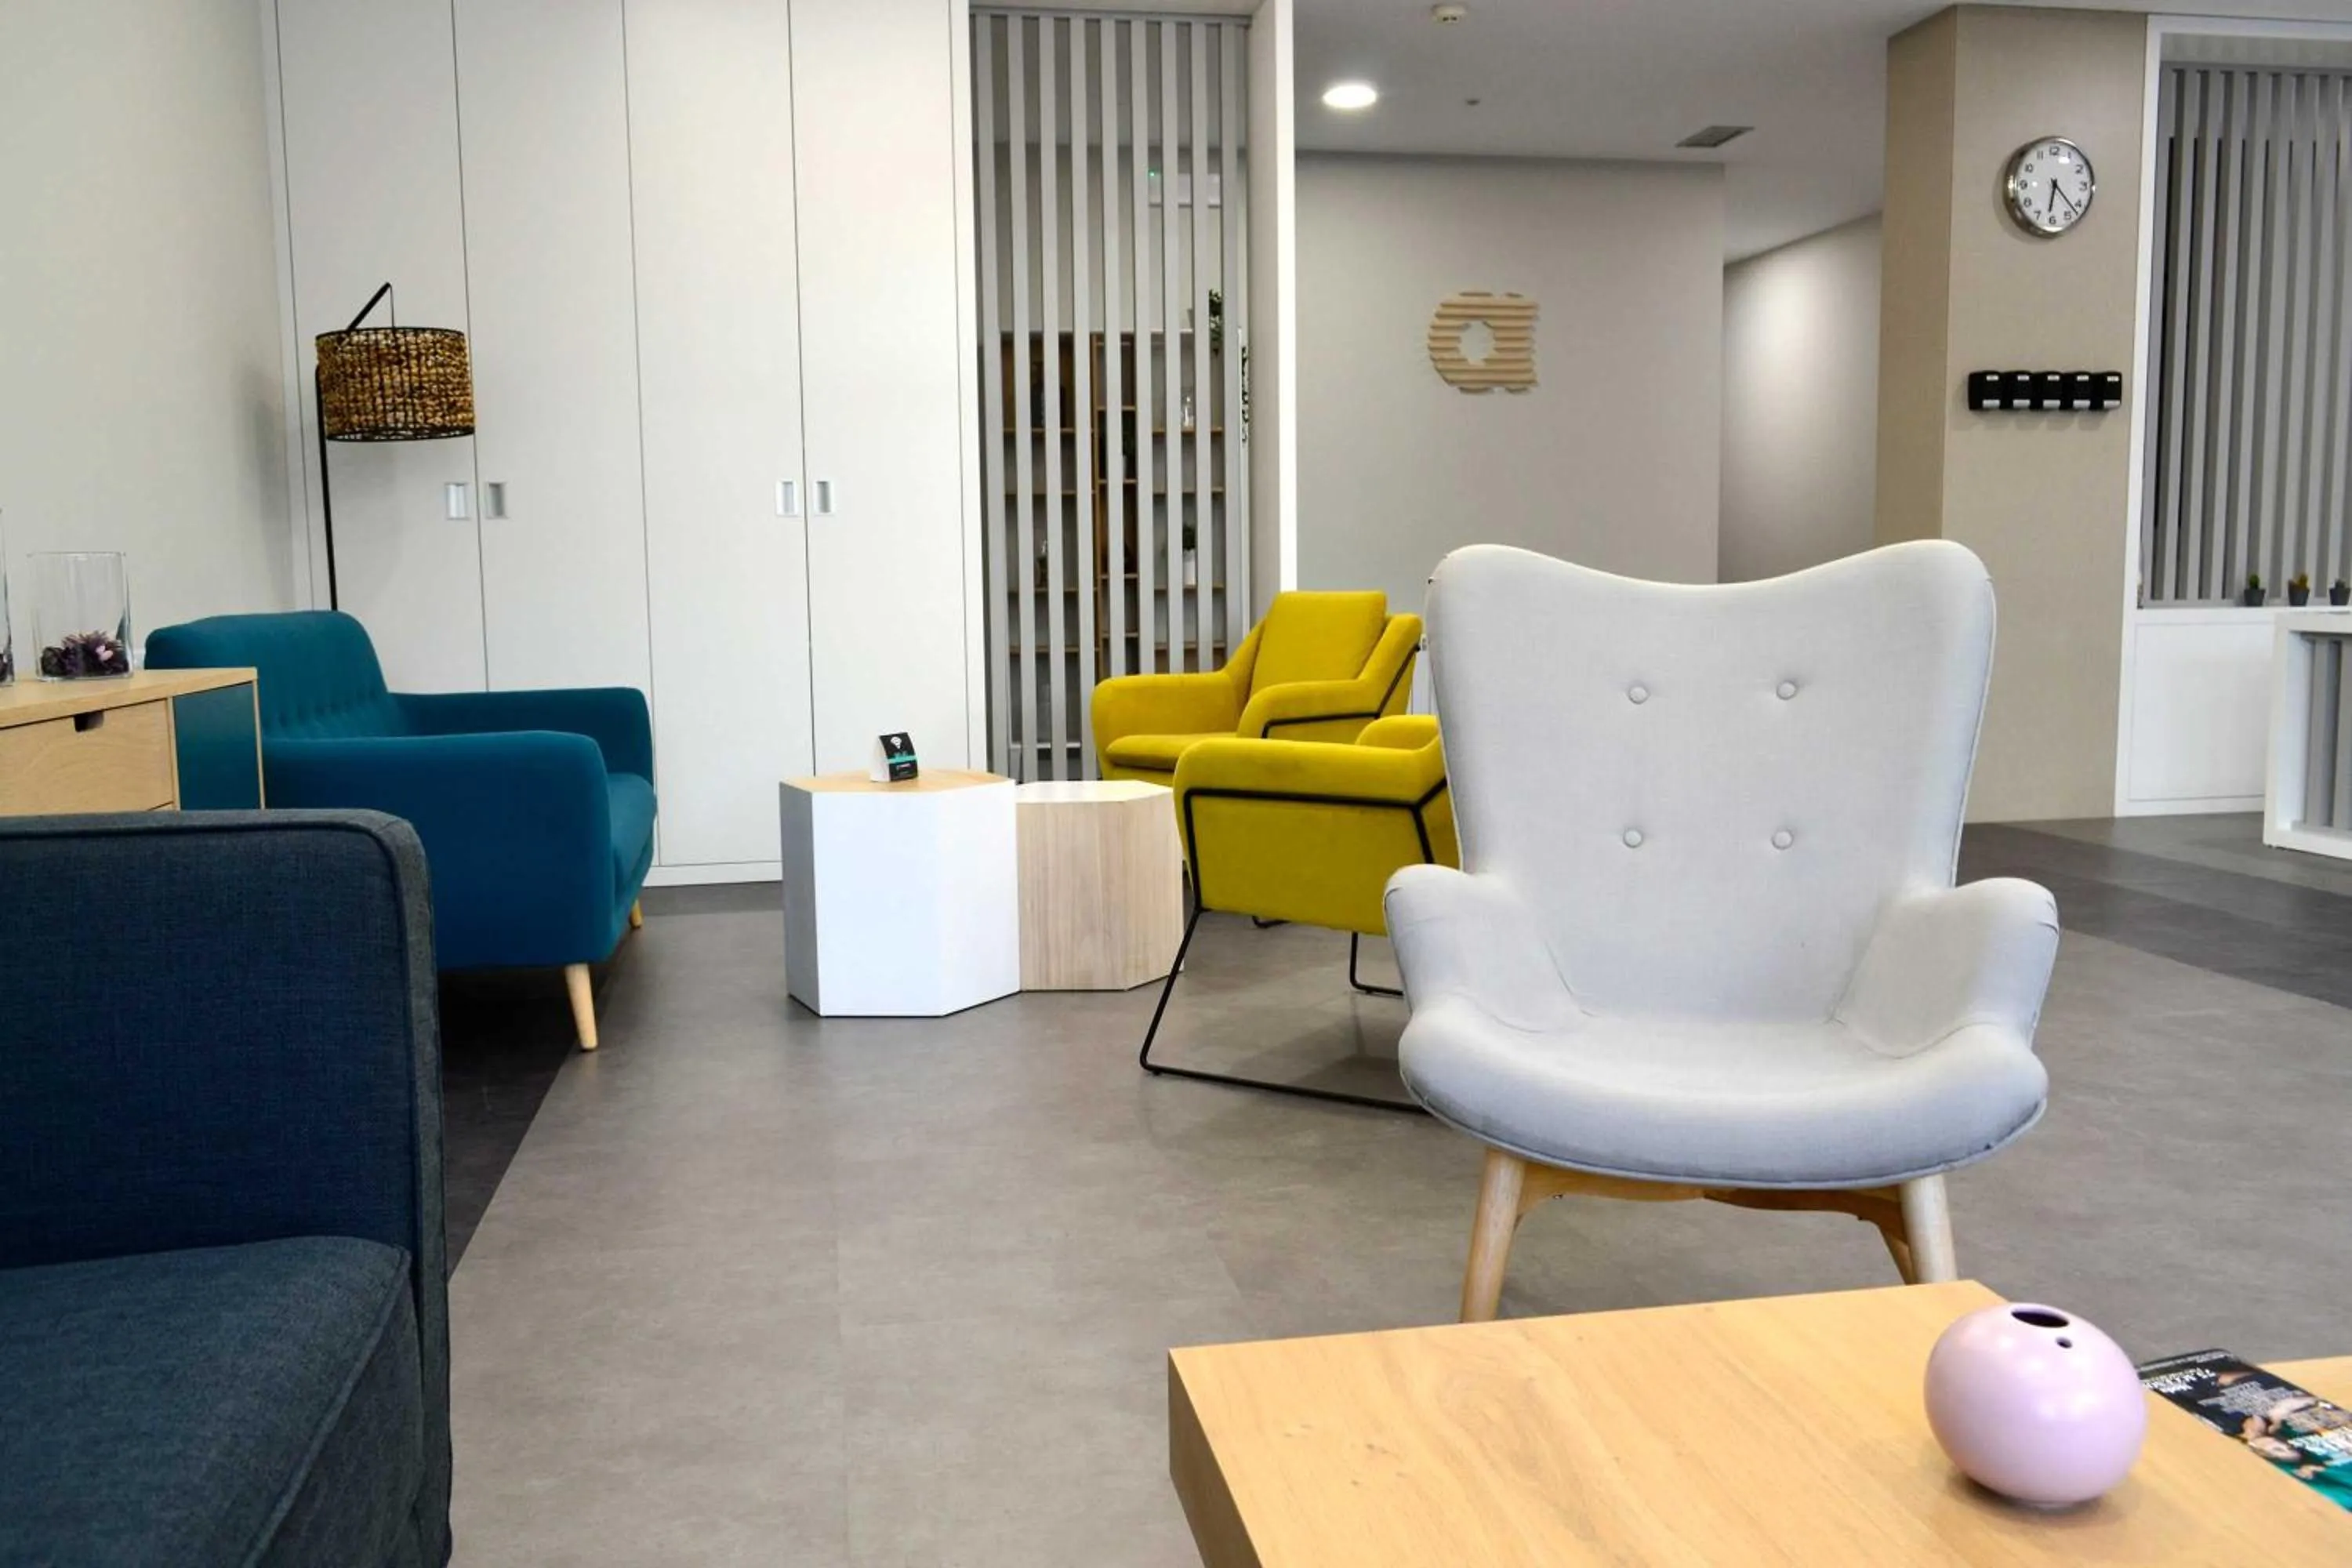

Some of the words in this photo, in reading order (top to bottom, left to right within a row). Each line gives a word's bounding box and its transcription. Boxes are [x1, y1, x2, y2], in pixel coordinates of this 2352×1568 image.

[2049, 146, 2060, 156] 12
[2075, 164, 2084, 174] 2
[2020, 180, 2027, 190] 9
[2079, 182, 2087, 191] 3
[2024, 198, 2032, 207] 8
[2074, 199, 2082, 208] 4
[2034, 210, 2042, 220] 7
[2063, 211, 2071, 220] 5
[2049, 216, 2056, 225] 6
